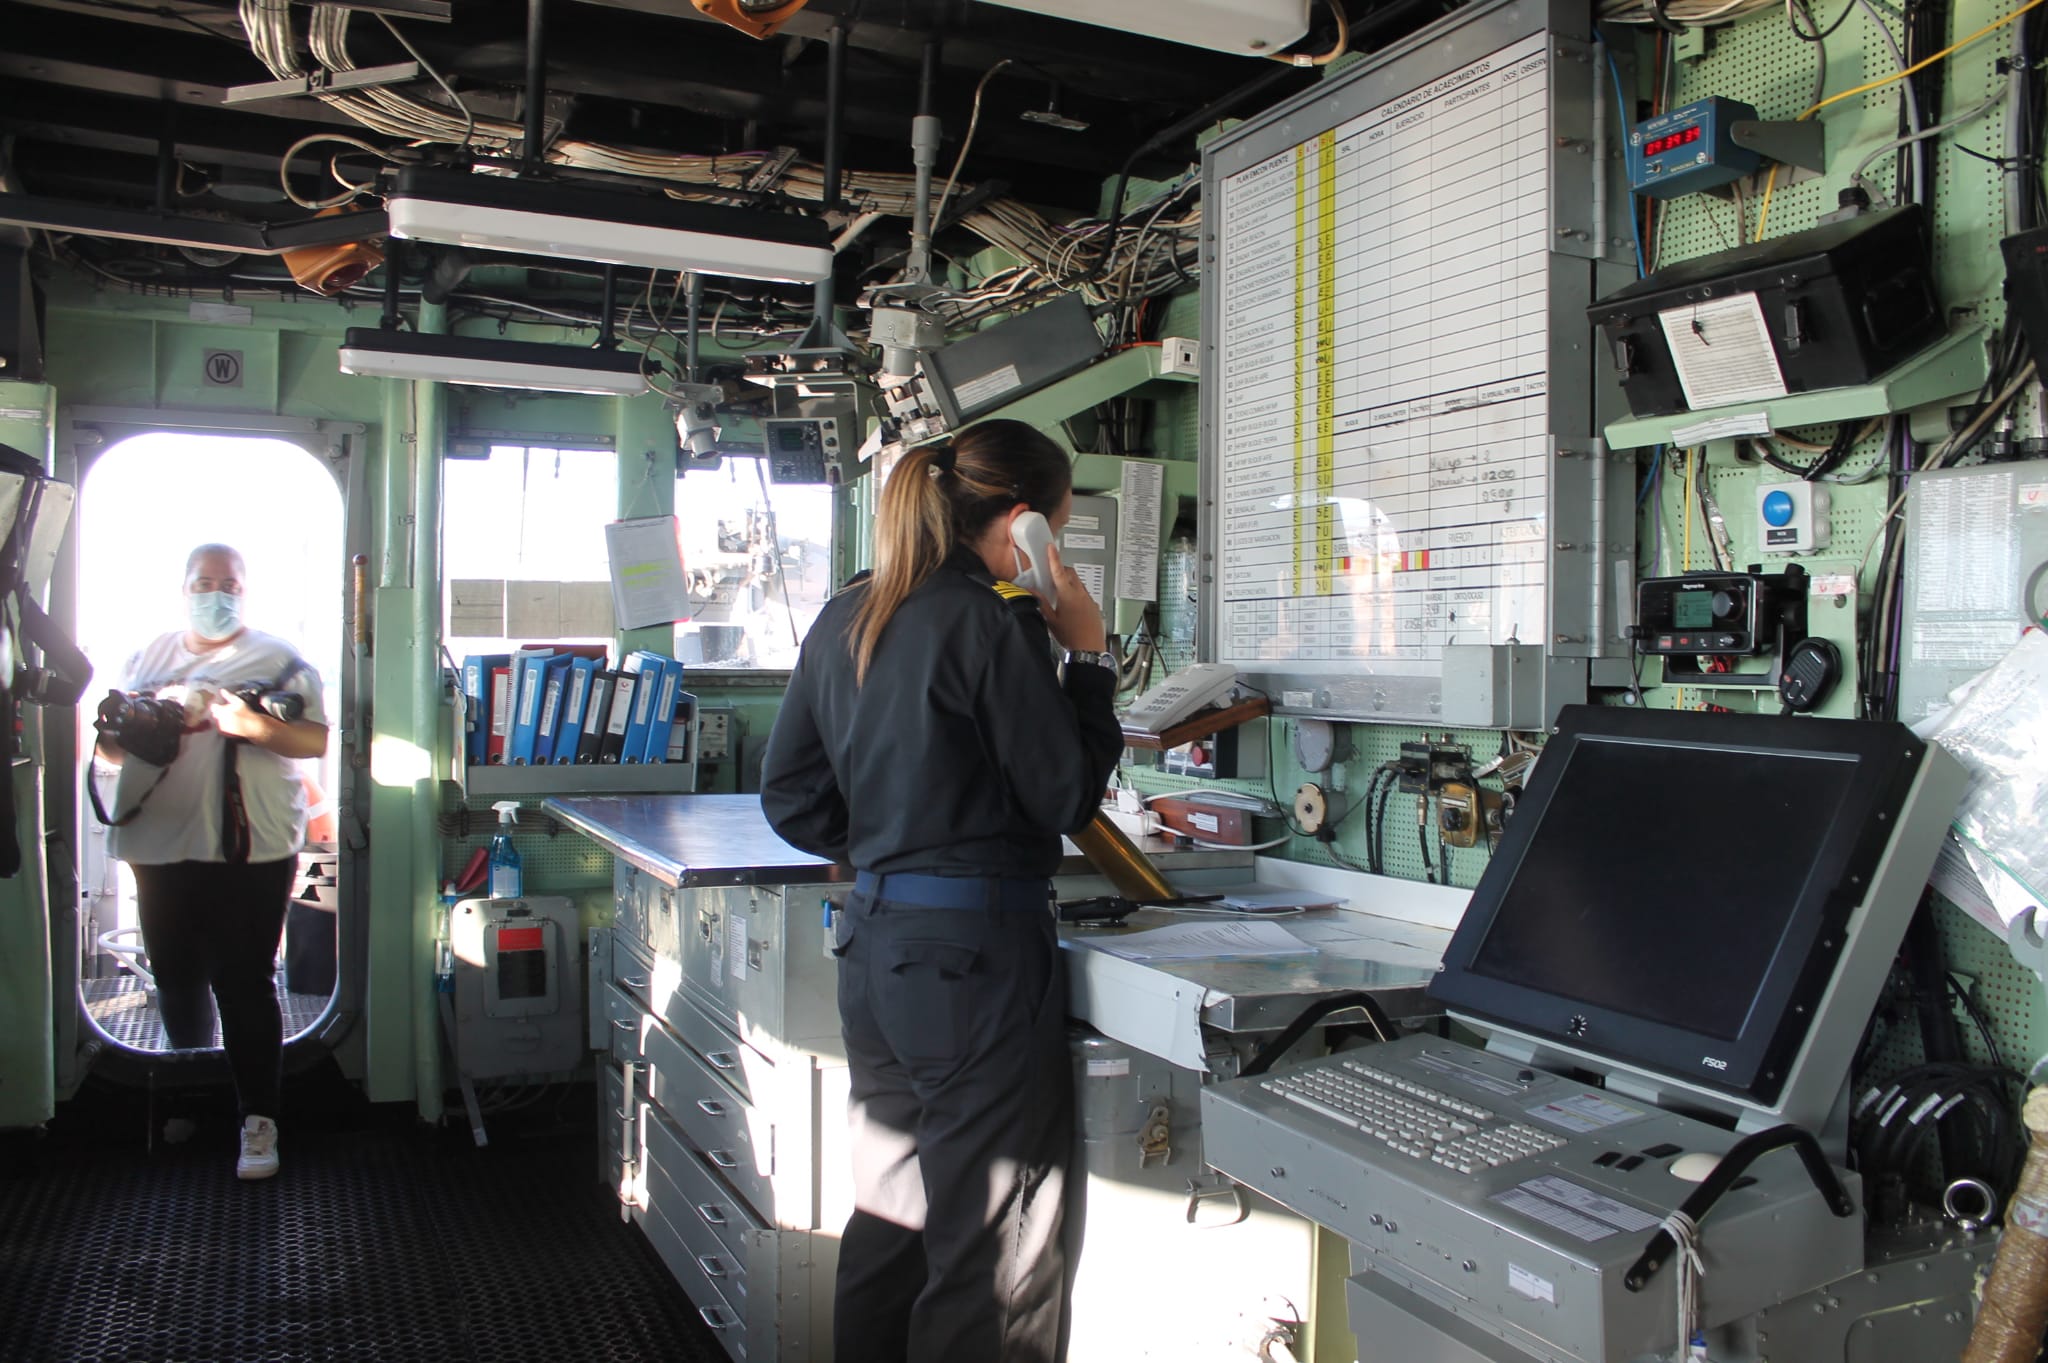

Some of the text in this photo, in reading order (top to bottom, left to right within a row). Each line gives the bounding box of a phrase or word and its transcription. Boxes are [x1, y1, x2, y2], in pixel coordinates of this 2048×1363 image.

[1381, 93, 1422, 118] CALENDARIO
[1434, 61, 1491, 96] ACAECIMIENTOS
[1444, 82, 1491, 108] PARTICIPANTES
[215, 358, 230, 378] W
